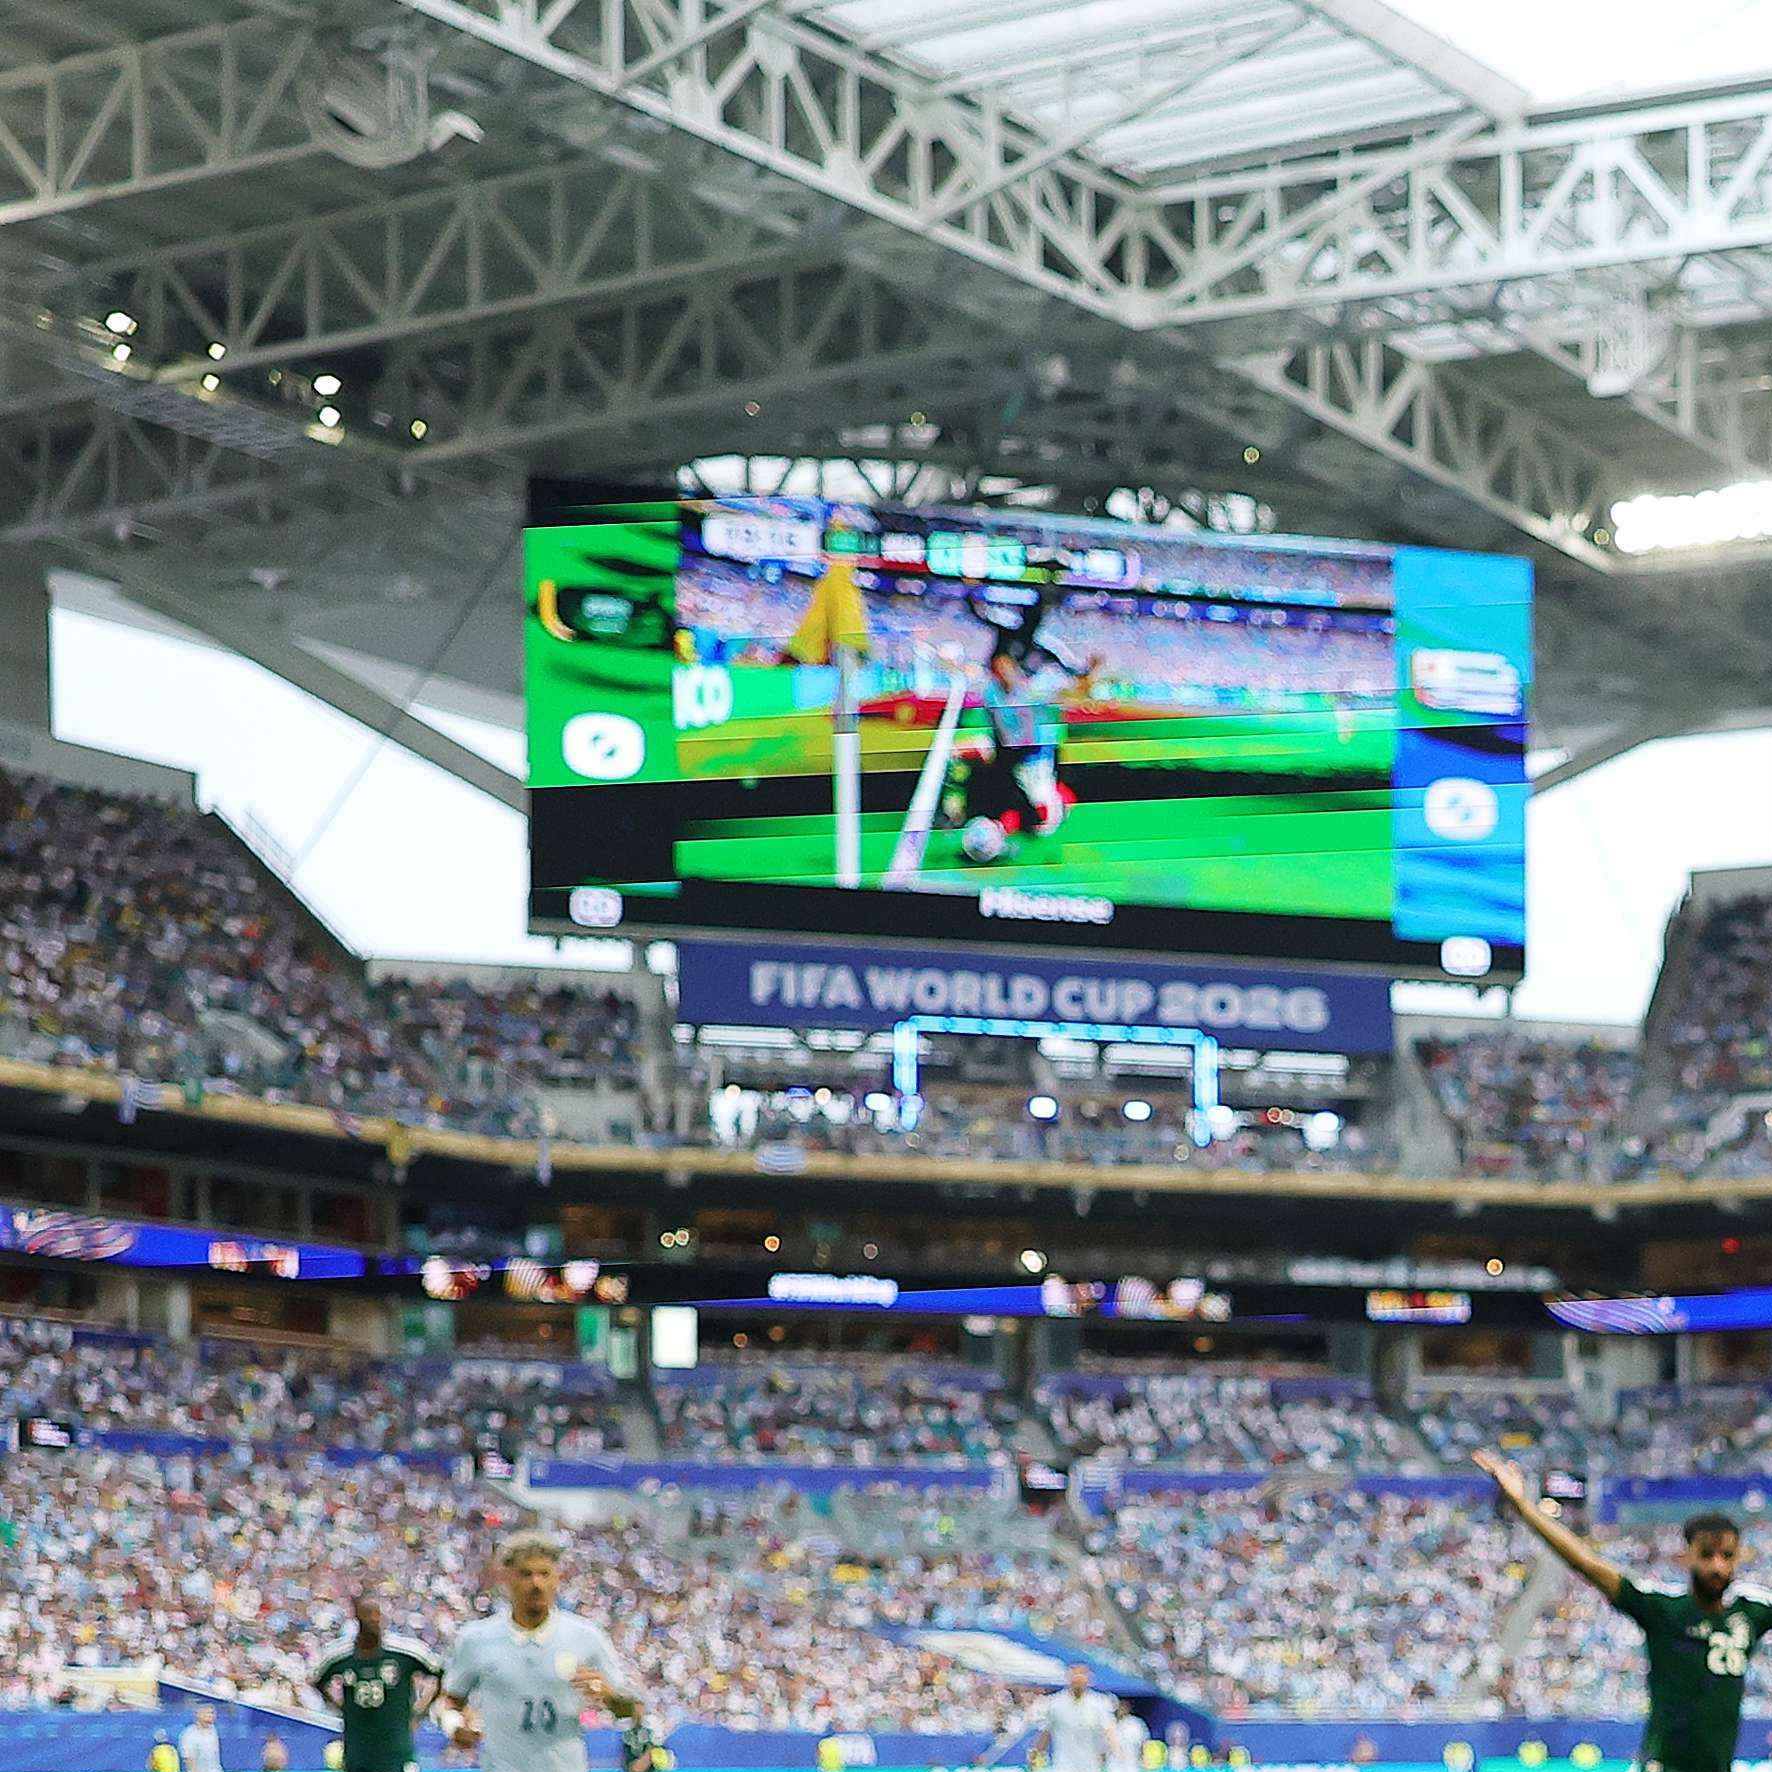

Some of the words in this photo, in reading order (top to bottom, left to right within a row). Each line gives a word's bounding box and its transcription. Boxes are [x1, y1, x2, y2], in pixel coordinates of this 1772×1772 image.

[751, 961, 861, 1009] FIFA
[864, 965, 1049, 1018] WORLD
[1053, 977, 1153, 1026] CUP
[1157, 982, 1329, 1033] 2026
